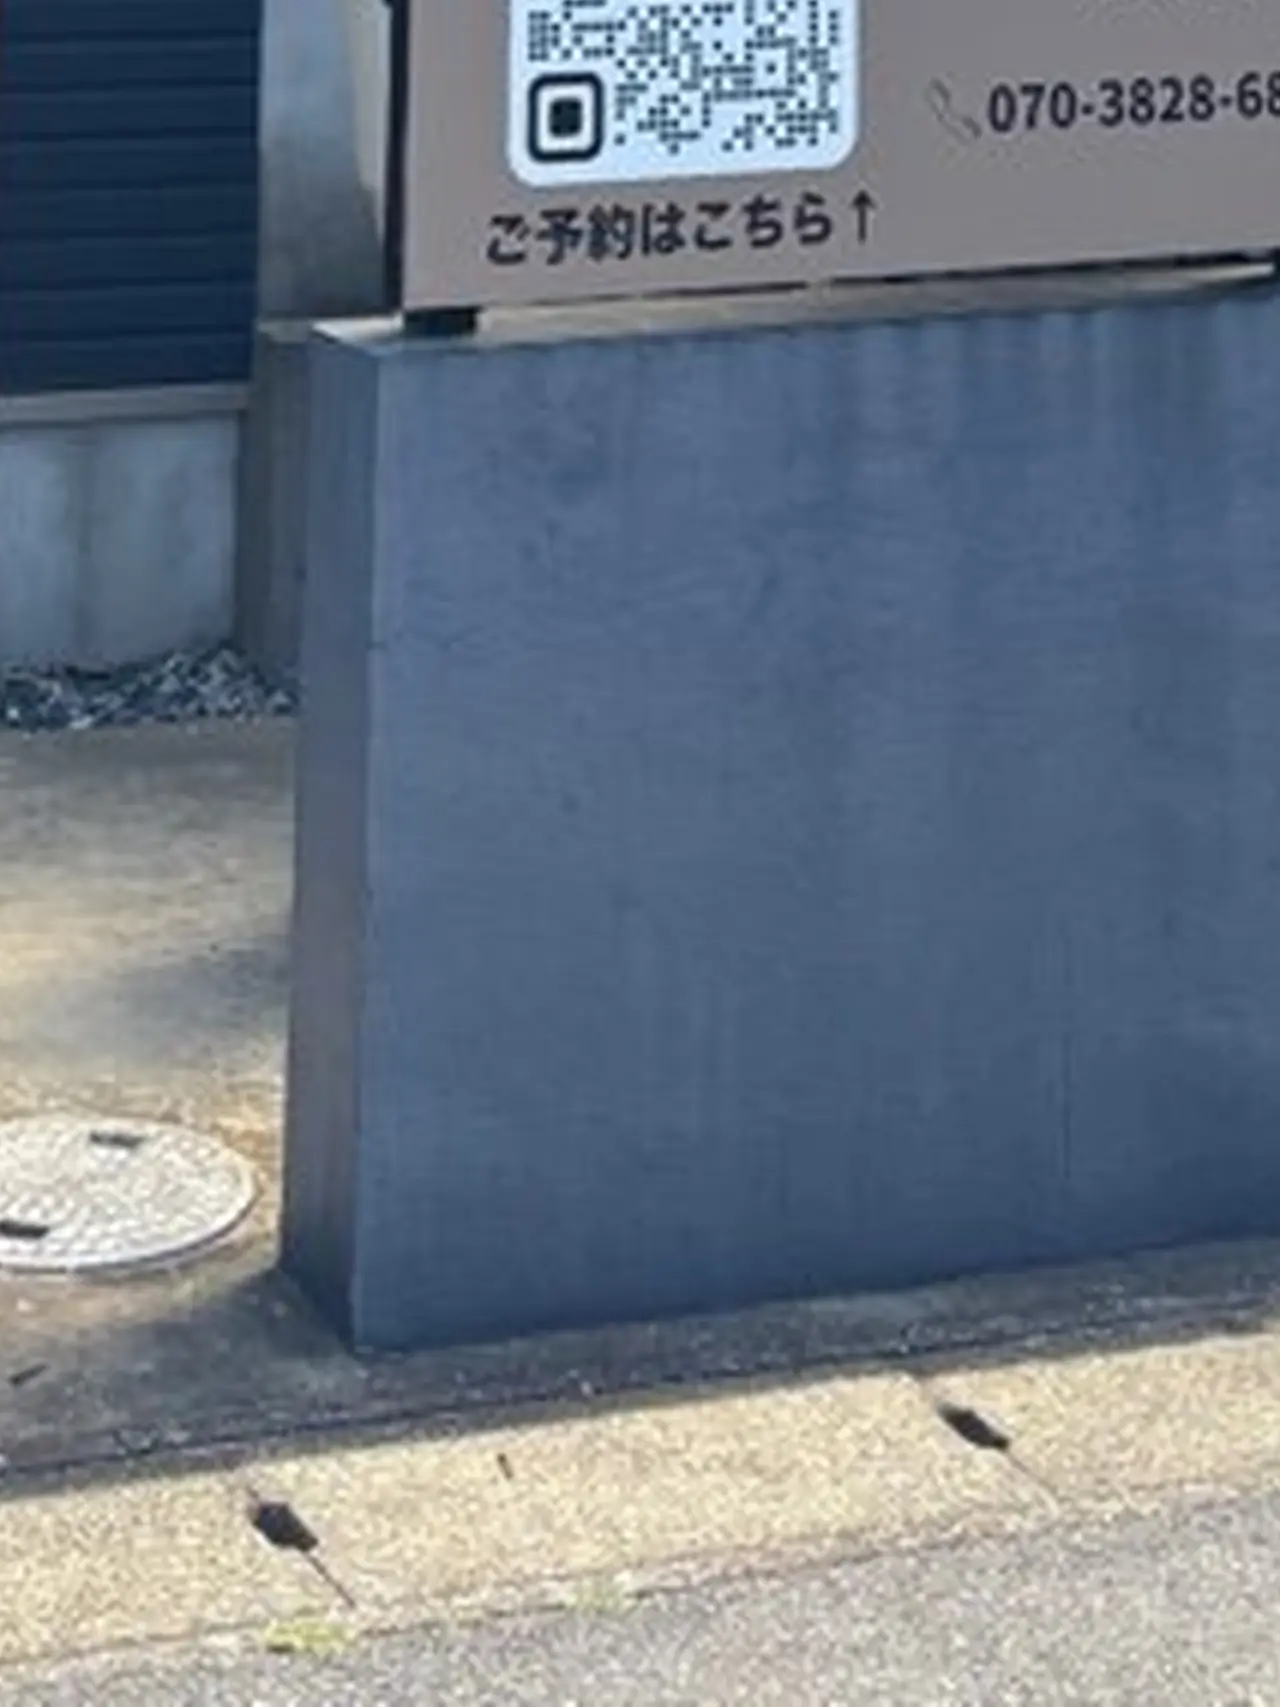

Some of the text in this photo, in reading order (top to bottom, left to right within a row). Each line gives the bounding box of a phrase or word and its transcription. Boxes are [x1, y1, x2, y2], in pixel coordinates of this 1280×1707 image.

[487, 191, 833, 266] ご予約はこちら
